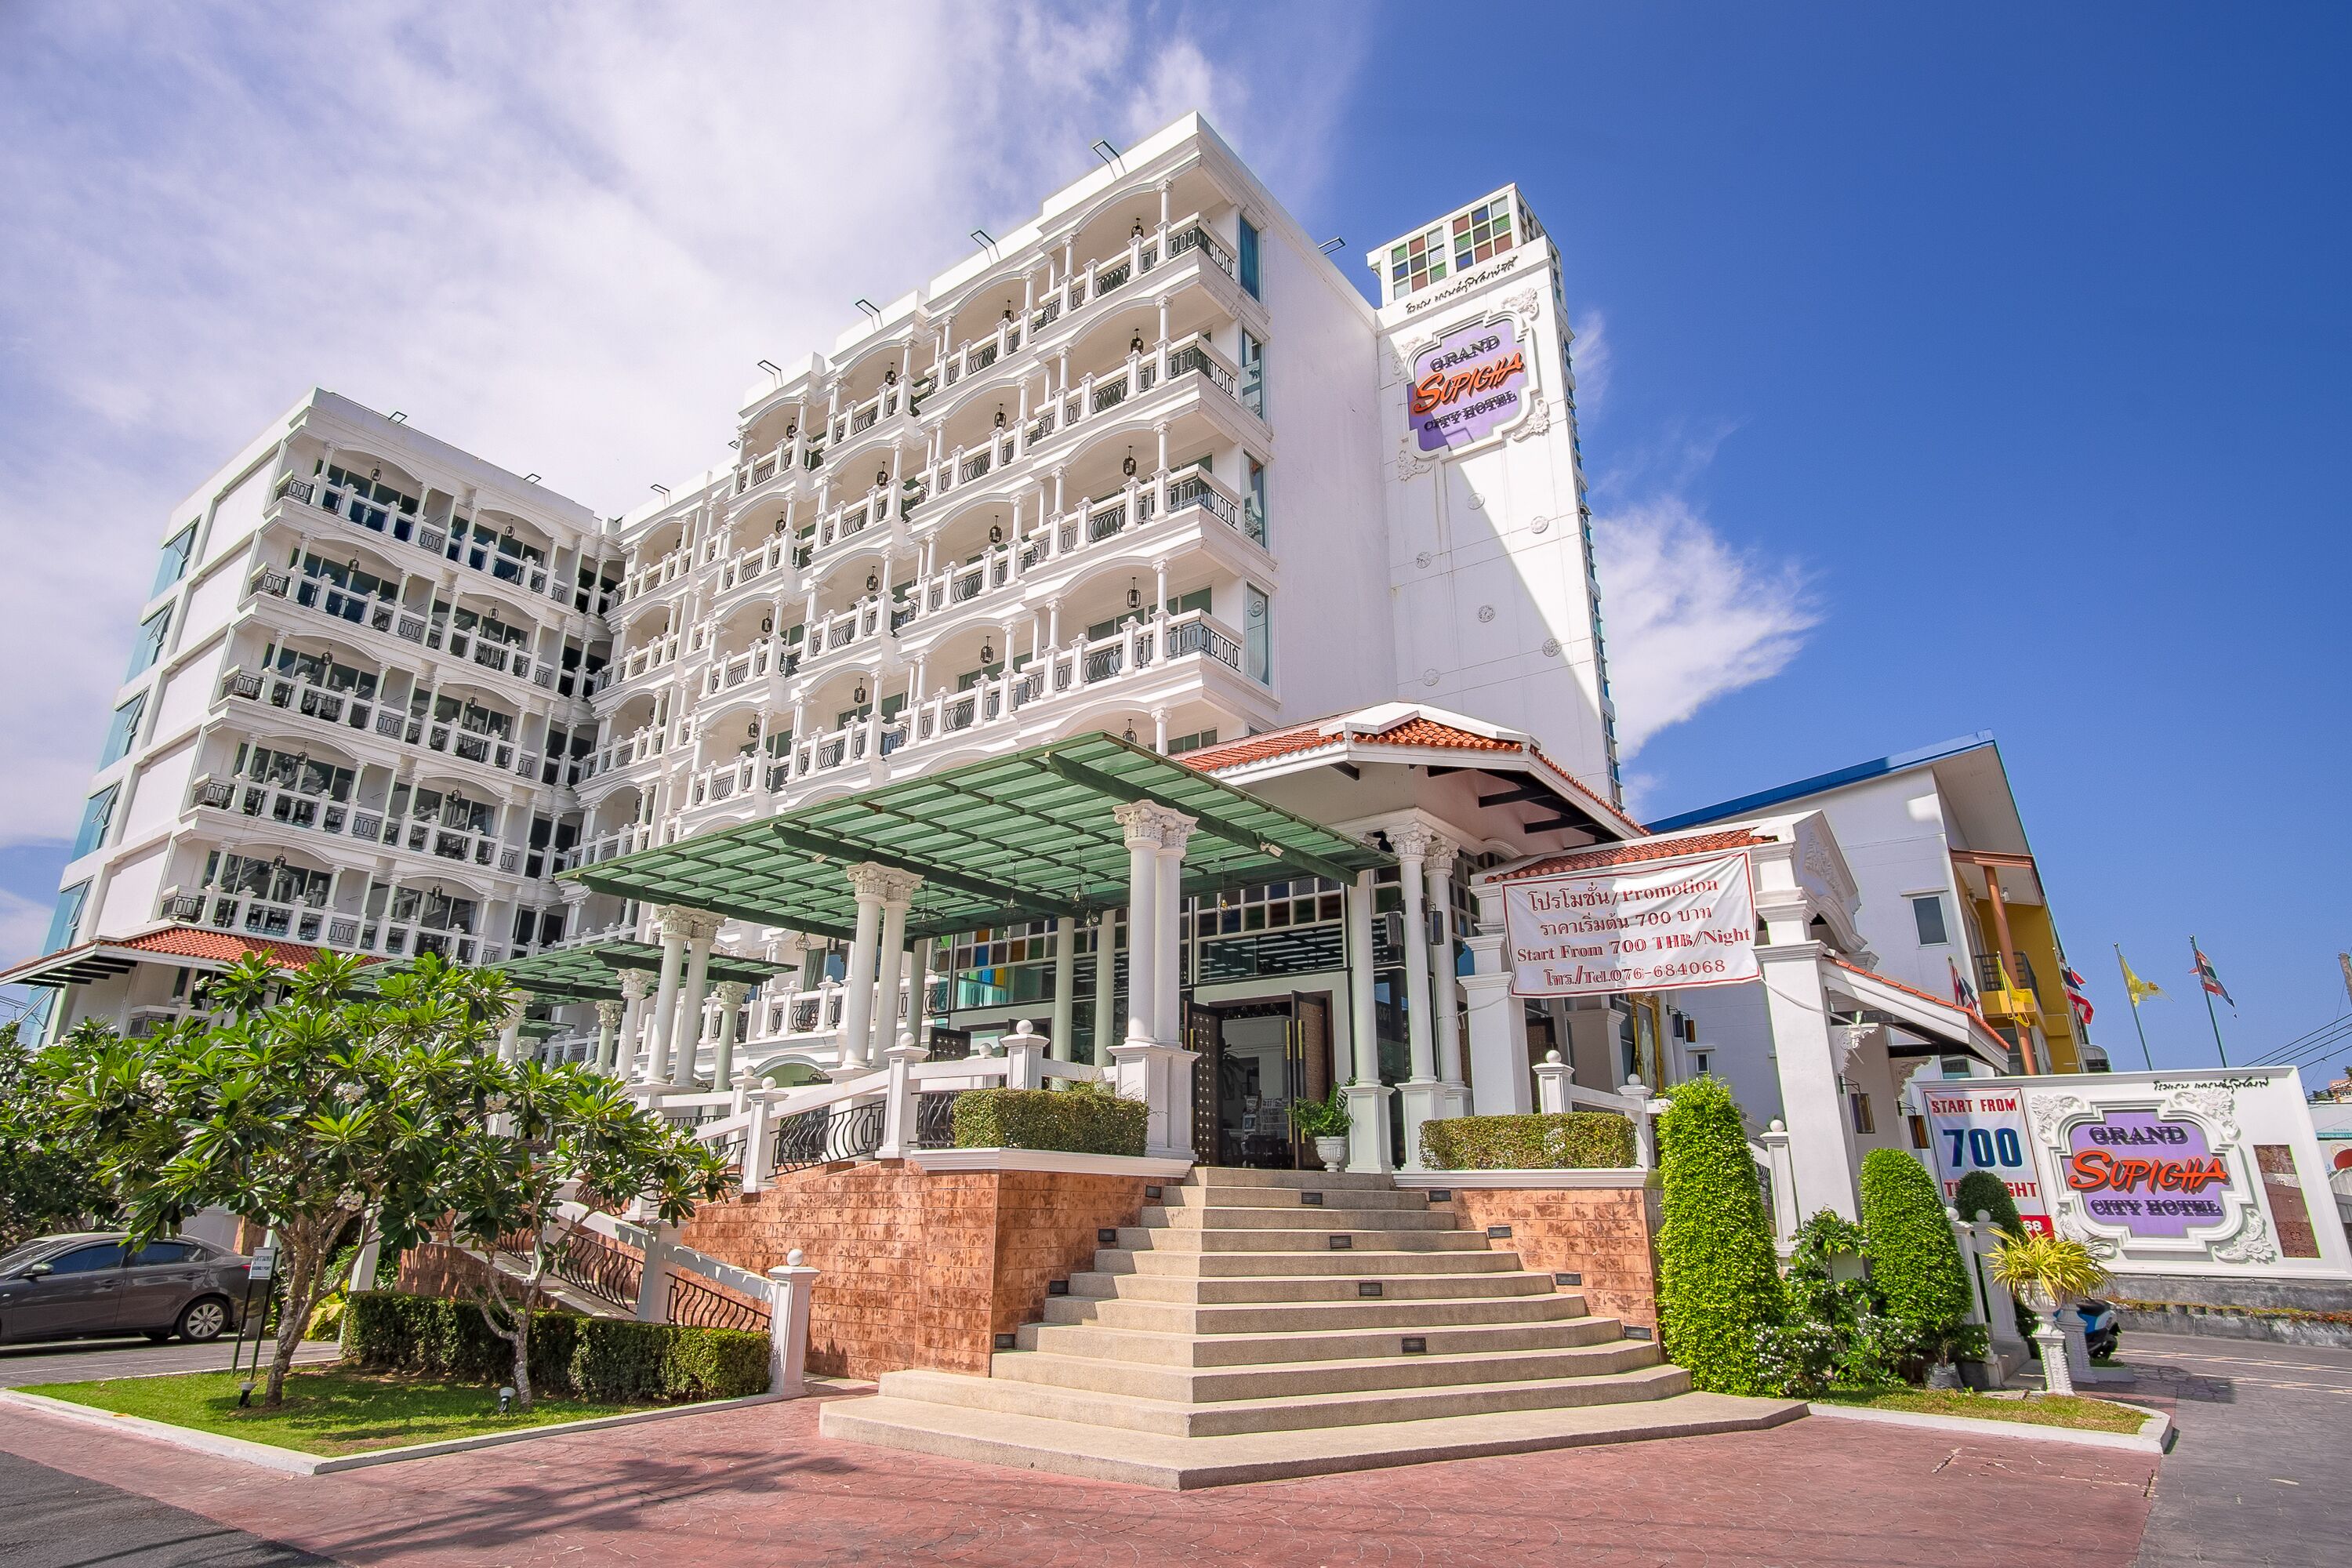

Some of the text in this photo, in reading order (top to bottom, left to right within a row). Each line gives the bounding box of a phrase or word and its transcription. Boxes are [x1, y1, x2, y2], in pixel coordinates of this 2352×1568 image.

[1430, 335, 1501, 372] GRAND
[1414, 352, 1525, 414] SUPICHA
[1424, 390, 1518, 431] CITY HOTEL
[1540, 907, 1712, 936] ราคาเริ่มต้น 700 บาท
[1517, 947, 1555, 962] Start
[1559, 944, 1603, 959] From
[1608, 938, 1646, 954] 700
[1931, 1098, 2017, 1113] START FROM
[1942, 1128, 2023, 1167] 700
[2089, 1127, 2188, 1145] GRAND
[2067, 1150, 2230, 1195] SUPICHA
[2089, 1200, 2223, 1217] CITY HOTEL
